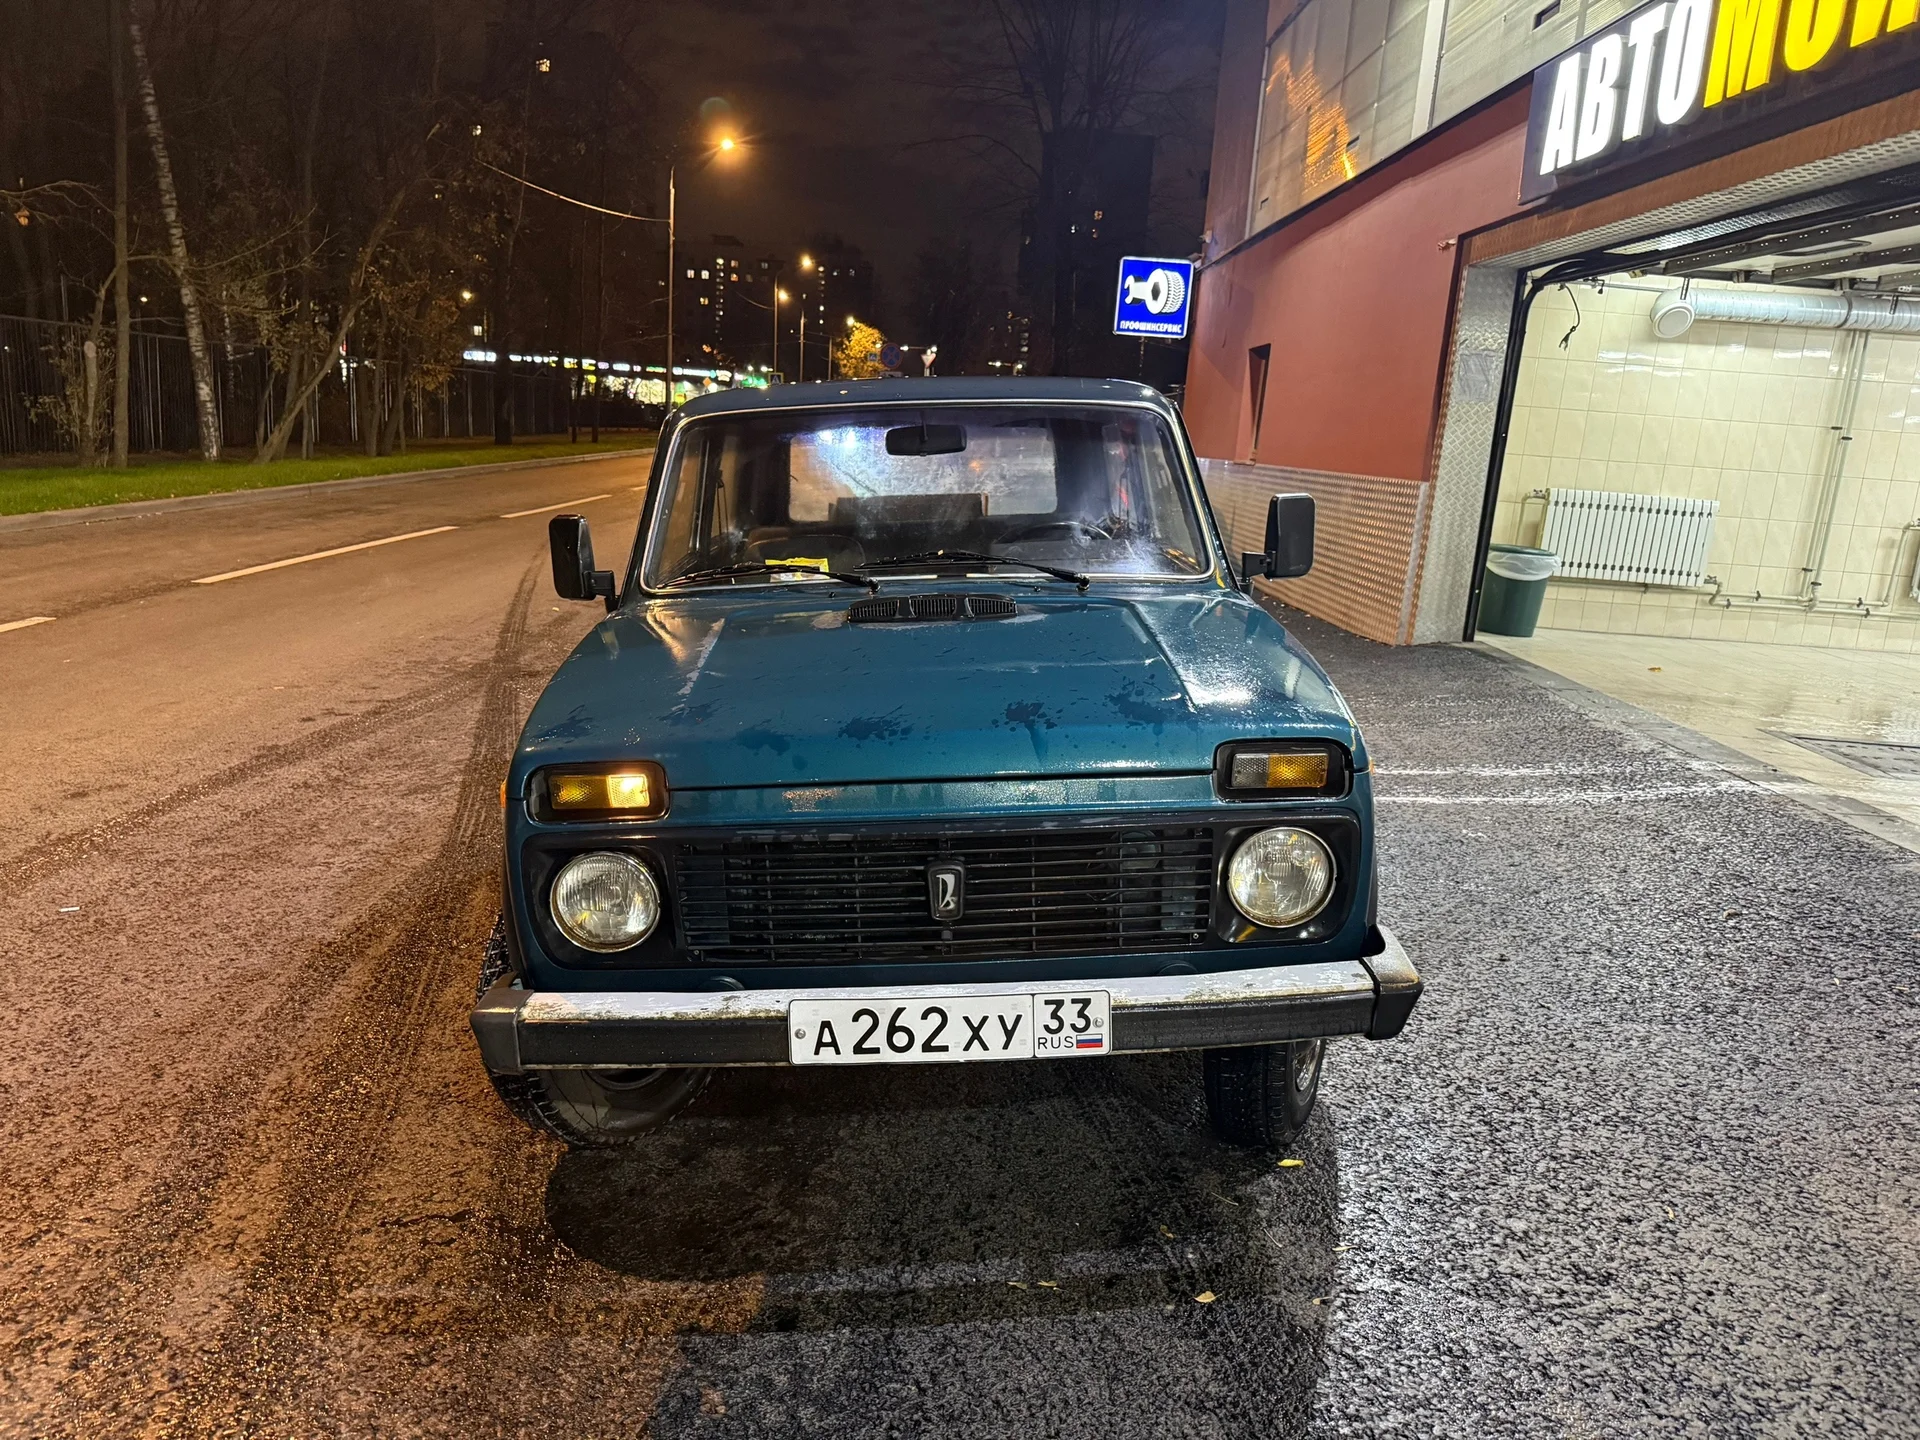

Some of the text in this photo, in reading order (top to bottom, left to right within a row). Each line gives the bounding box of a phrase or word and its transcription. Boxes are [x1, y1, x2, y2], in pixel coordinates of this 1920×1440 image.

[1120, 320, 1182, 333] ПРОФШИНСЕРВИС
[1043, 998, 1092, 1034] 33
[1037, 1035, 1075, 1050] RUS
